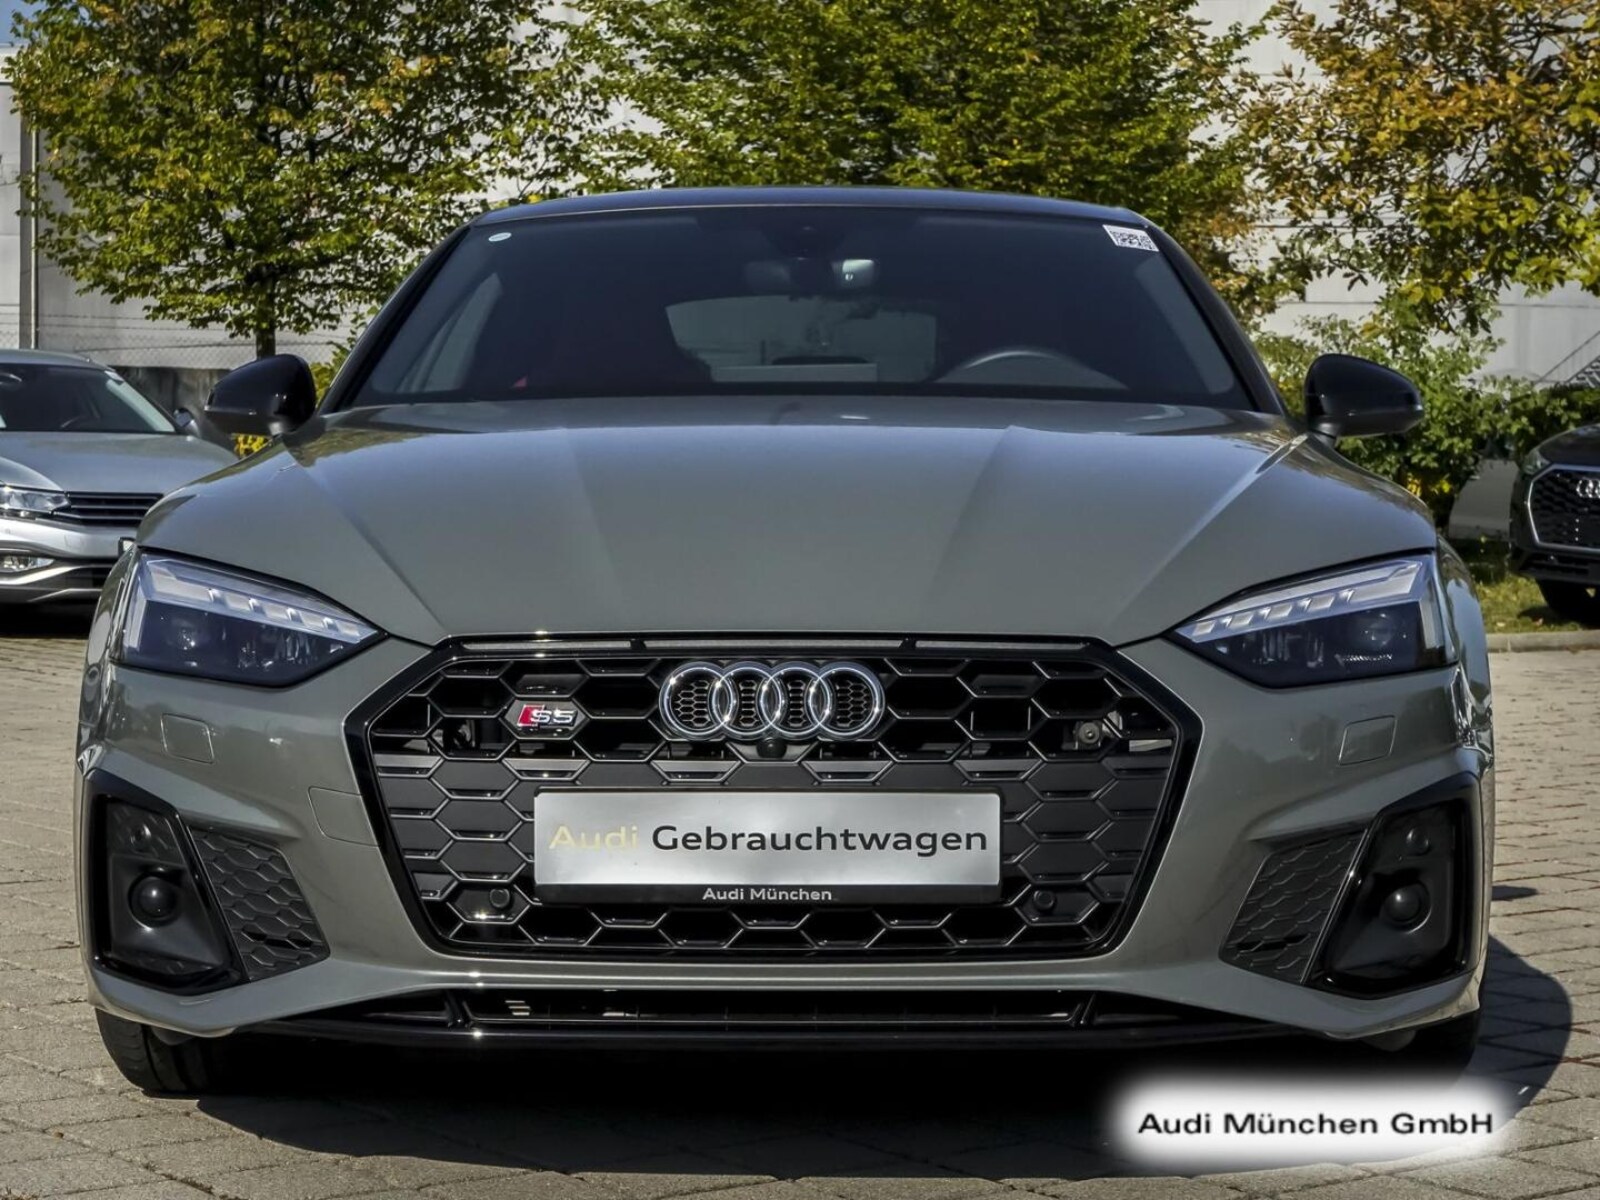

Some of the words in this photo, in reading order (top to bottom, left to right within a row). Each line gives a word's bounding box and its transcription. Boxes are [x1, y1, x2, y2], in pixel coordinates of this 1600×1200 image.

[528, 707, 577, 725] S5
[548, 825, 638, 850] Audi
[652, 825, 987, 857] Gebrauchtwagen
[702, 887, 745, 901] Audi
[749, 887, 832, 901] München
